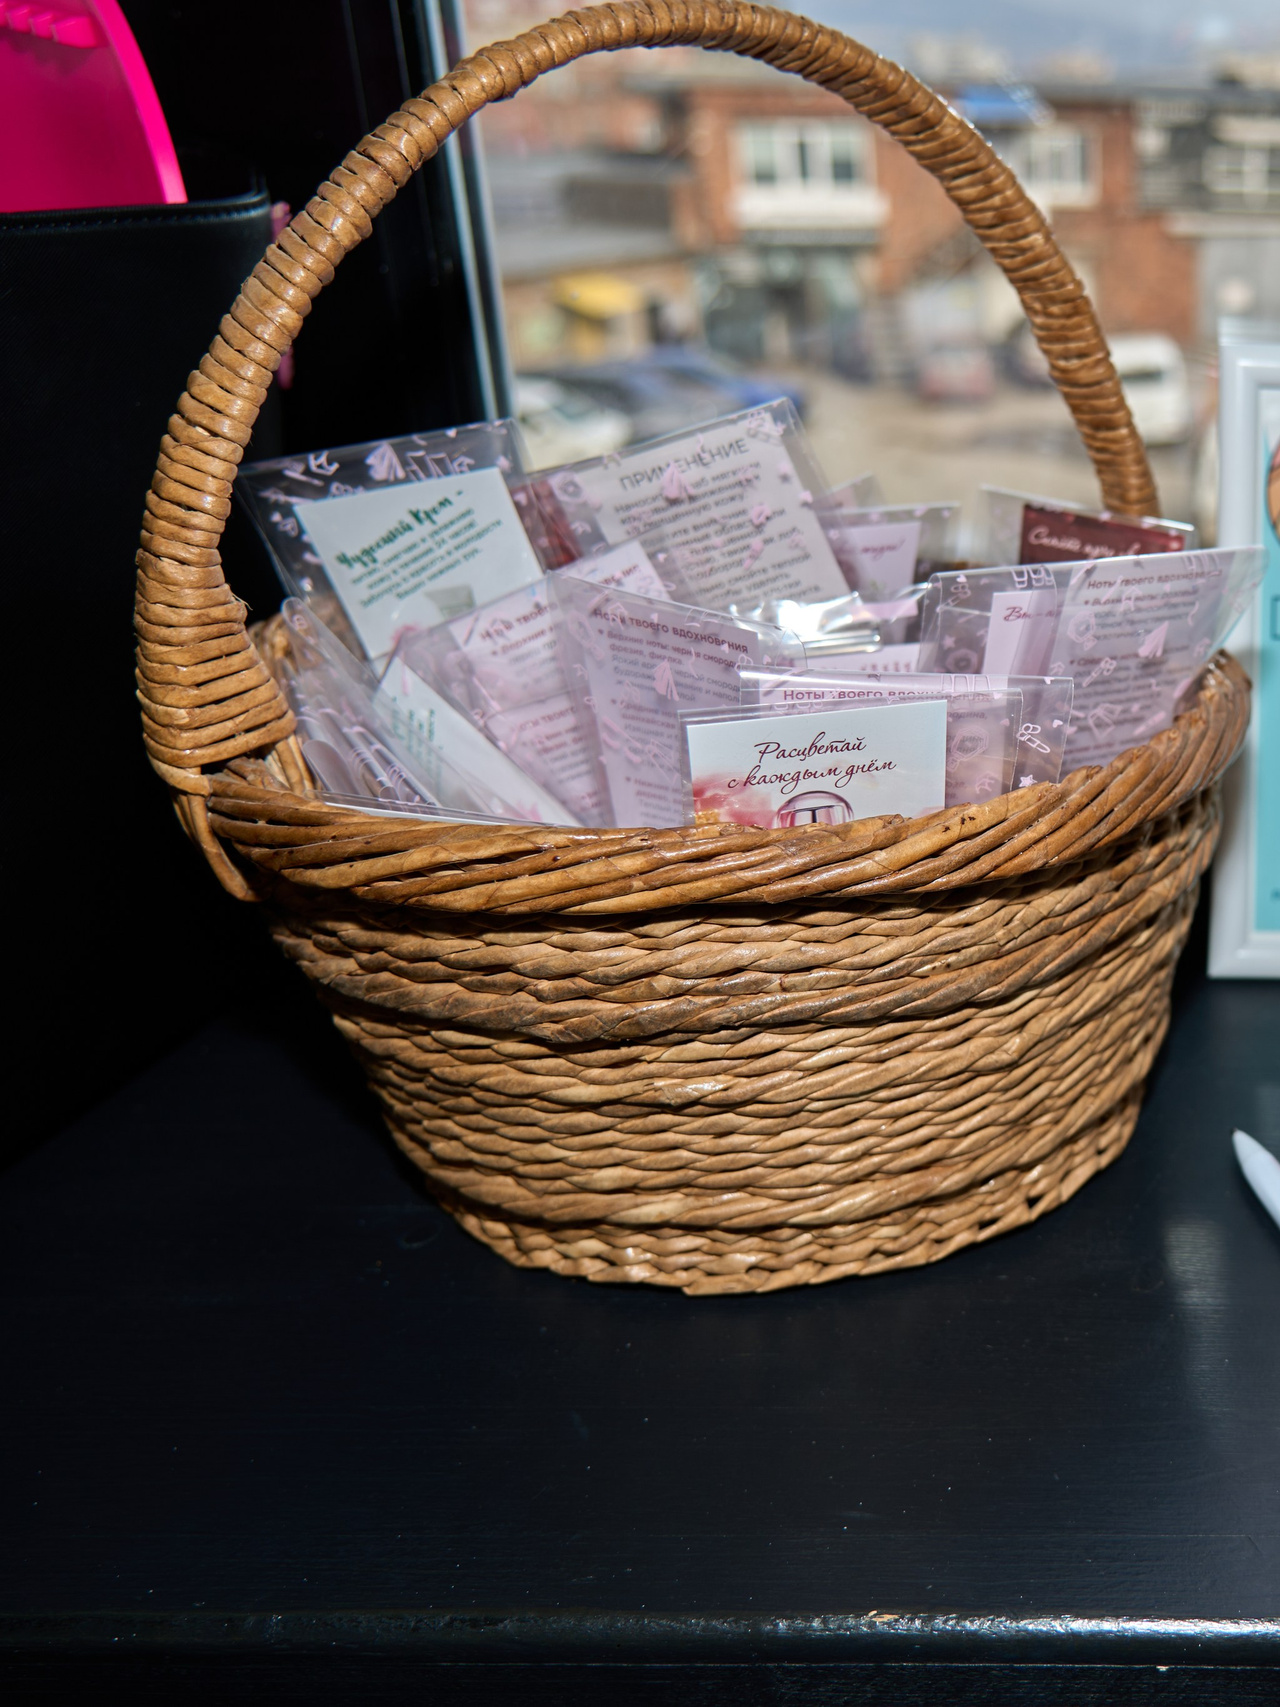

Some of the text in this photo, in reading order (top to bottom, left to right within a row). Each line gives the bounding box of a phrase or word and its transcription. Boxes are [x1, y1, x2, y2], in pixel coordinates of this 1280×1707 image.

[408, 496, 453, 525] Крем
[628, 614, 670, 634] твоего
[671, 625, 749, 655] вдохновения
[753, 731, 868, 764] Расцветай
[727, 758, 898, 795] с каждым днём
